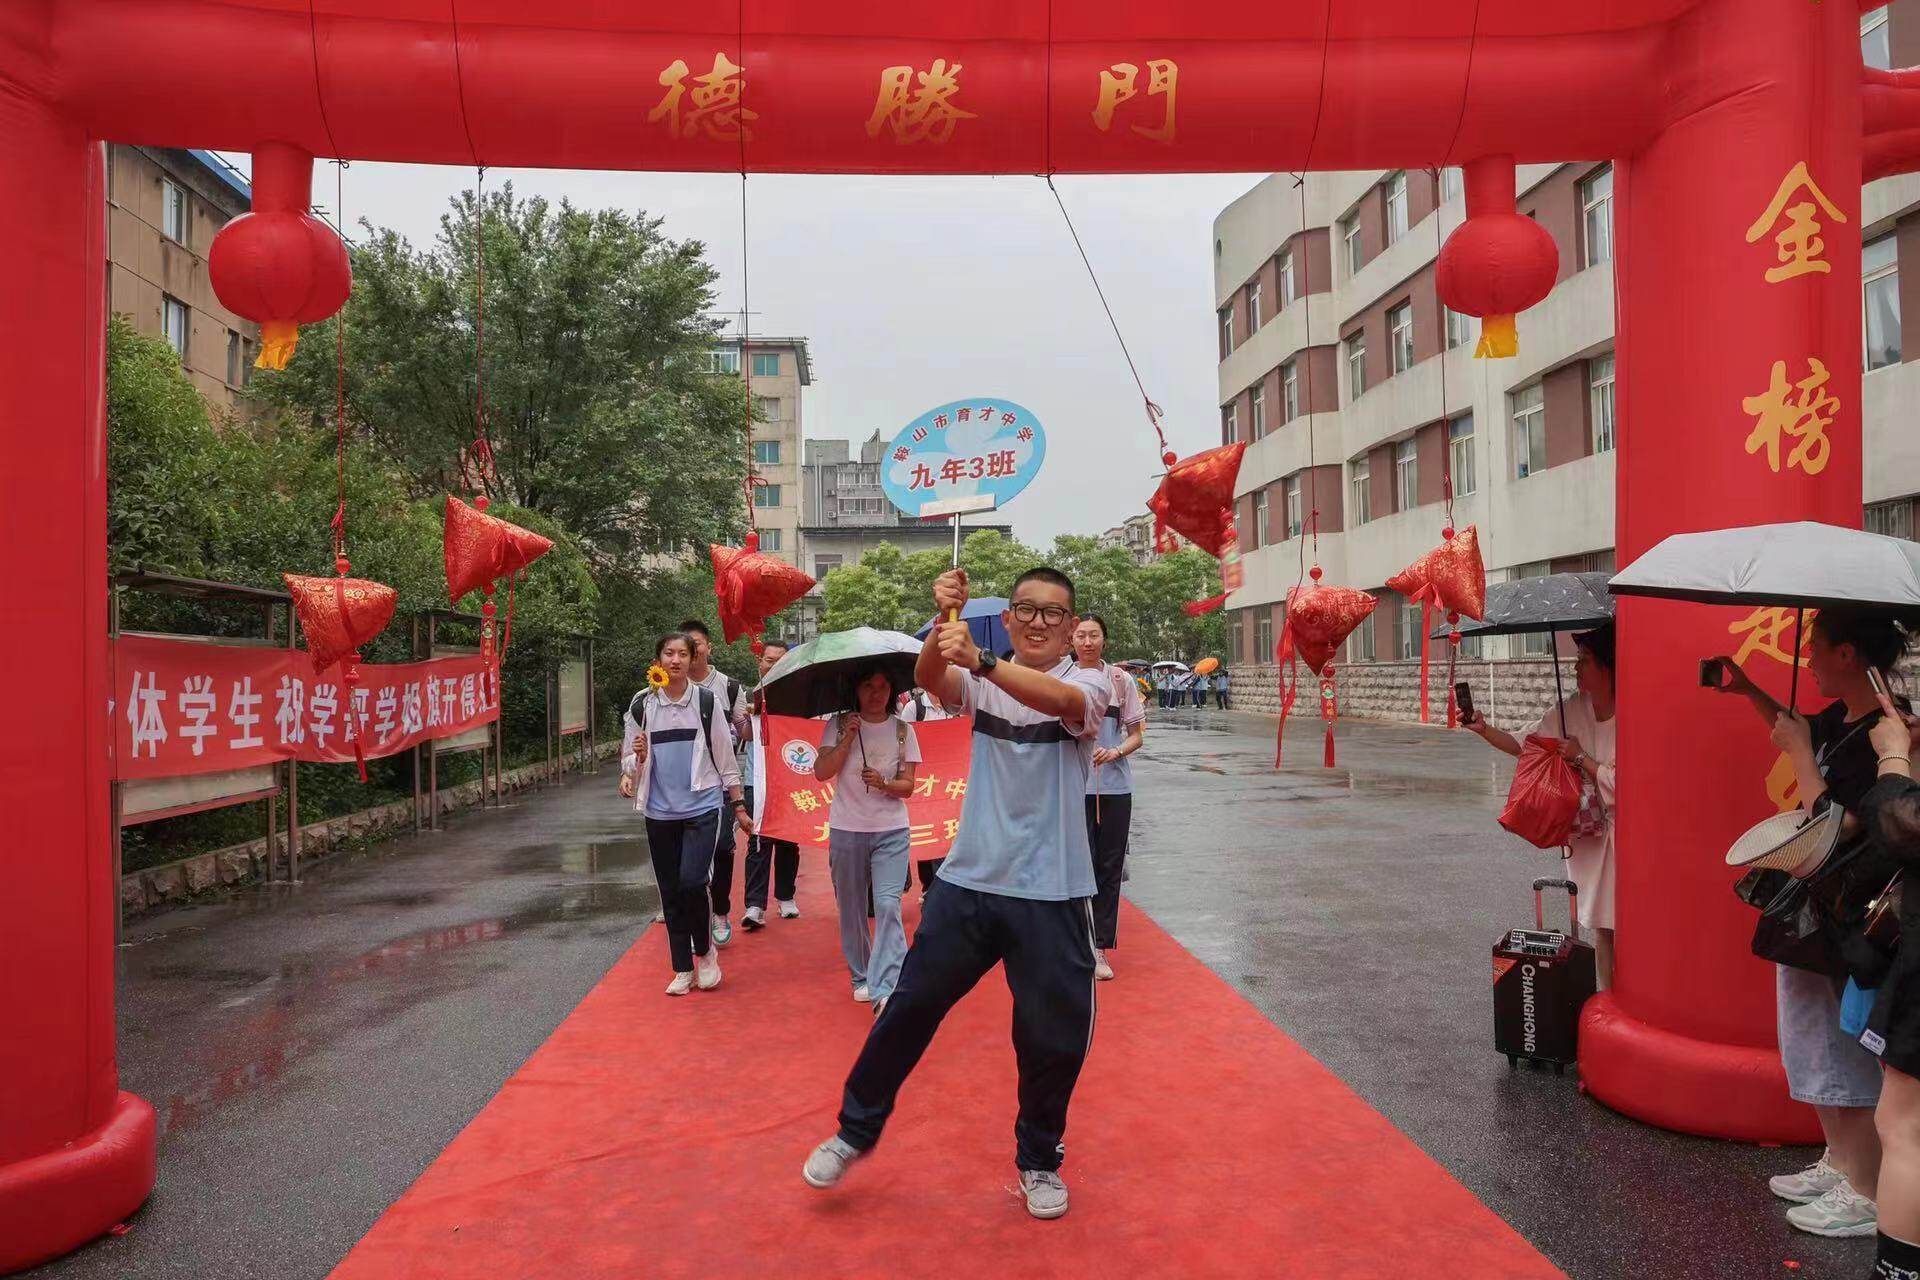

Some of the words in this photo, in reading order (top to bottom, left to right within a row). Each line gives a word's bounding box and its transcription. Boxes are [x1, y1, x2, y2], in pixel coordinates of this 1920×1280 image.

[893, 405, 1034, 463] 鞍山市育才中学
[908, 449, 1017, 491] 九年3班
[108, 670, 497, 758] 体学生祝学哥学姐旗开得胜
[1521, 963, 1536, 1053] CHANGHONG
